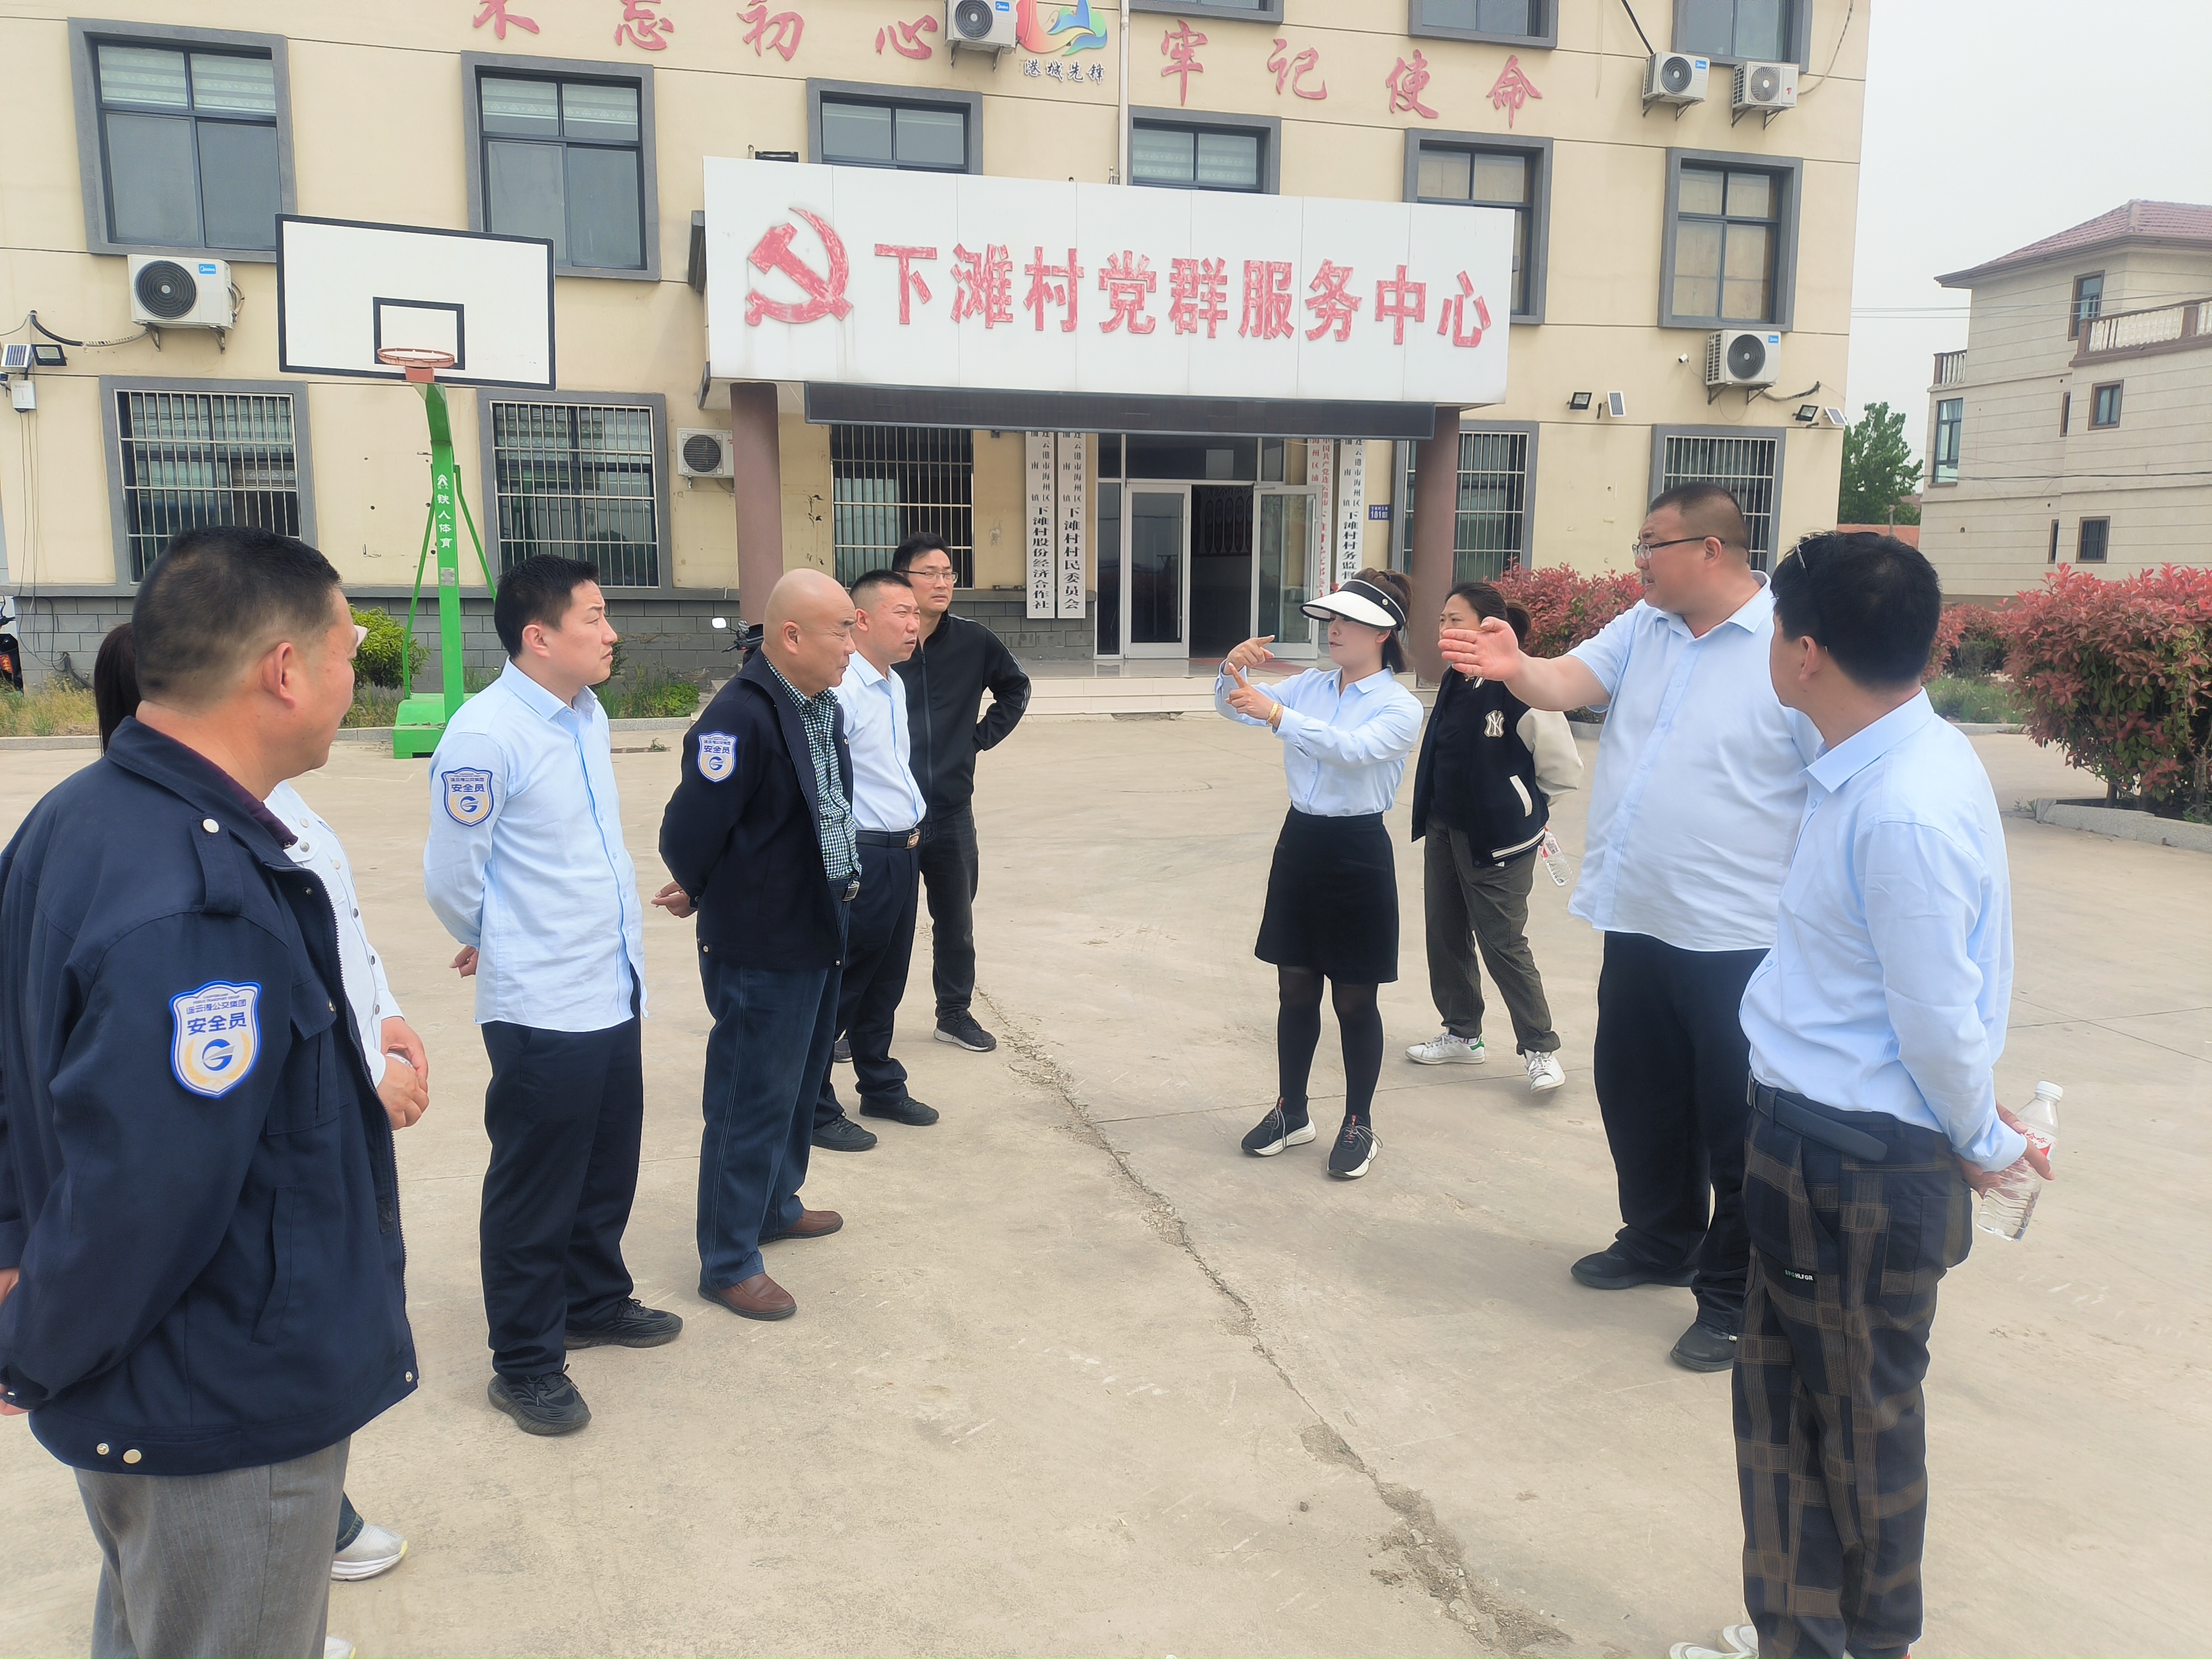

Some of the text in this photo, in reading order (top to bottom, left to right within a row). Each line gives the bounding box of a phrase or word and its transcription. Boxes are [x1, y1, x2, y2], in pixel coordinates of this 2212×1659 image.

[1025, 58, 1104, 84] 港城先锋
[1161, 19, 1543, 129] 牢记使命
[874, 242, 1491, 347] 下滩村党群服务中心
[1032, 506, 1050, 609] 下滩村股份经济合作社
[1063, 507, 1081, 609] 下滩村村民委员会
[703, 745, 731, 754] 安全员
[187, 1012, 247, 1036] 安全员
